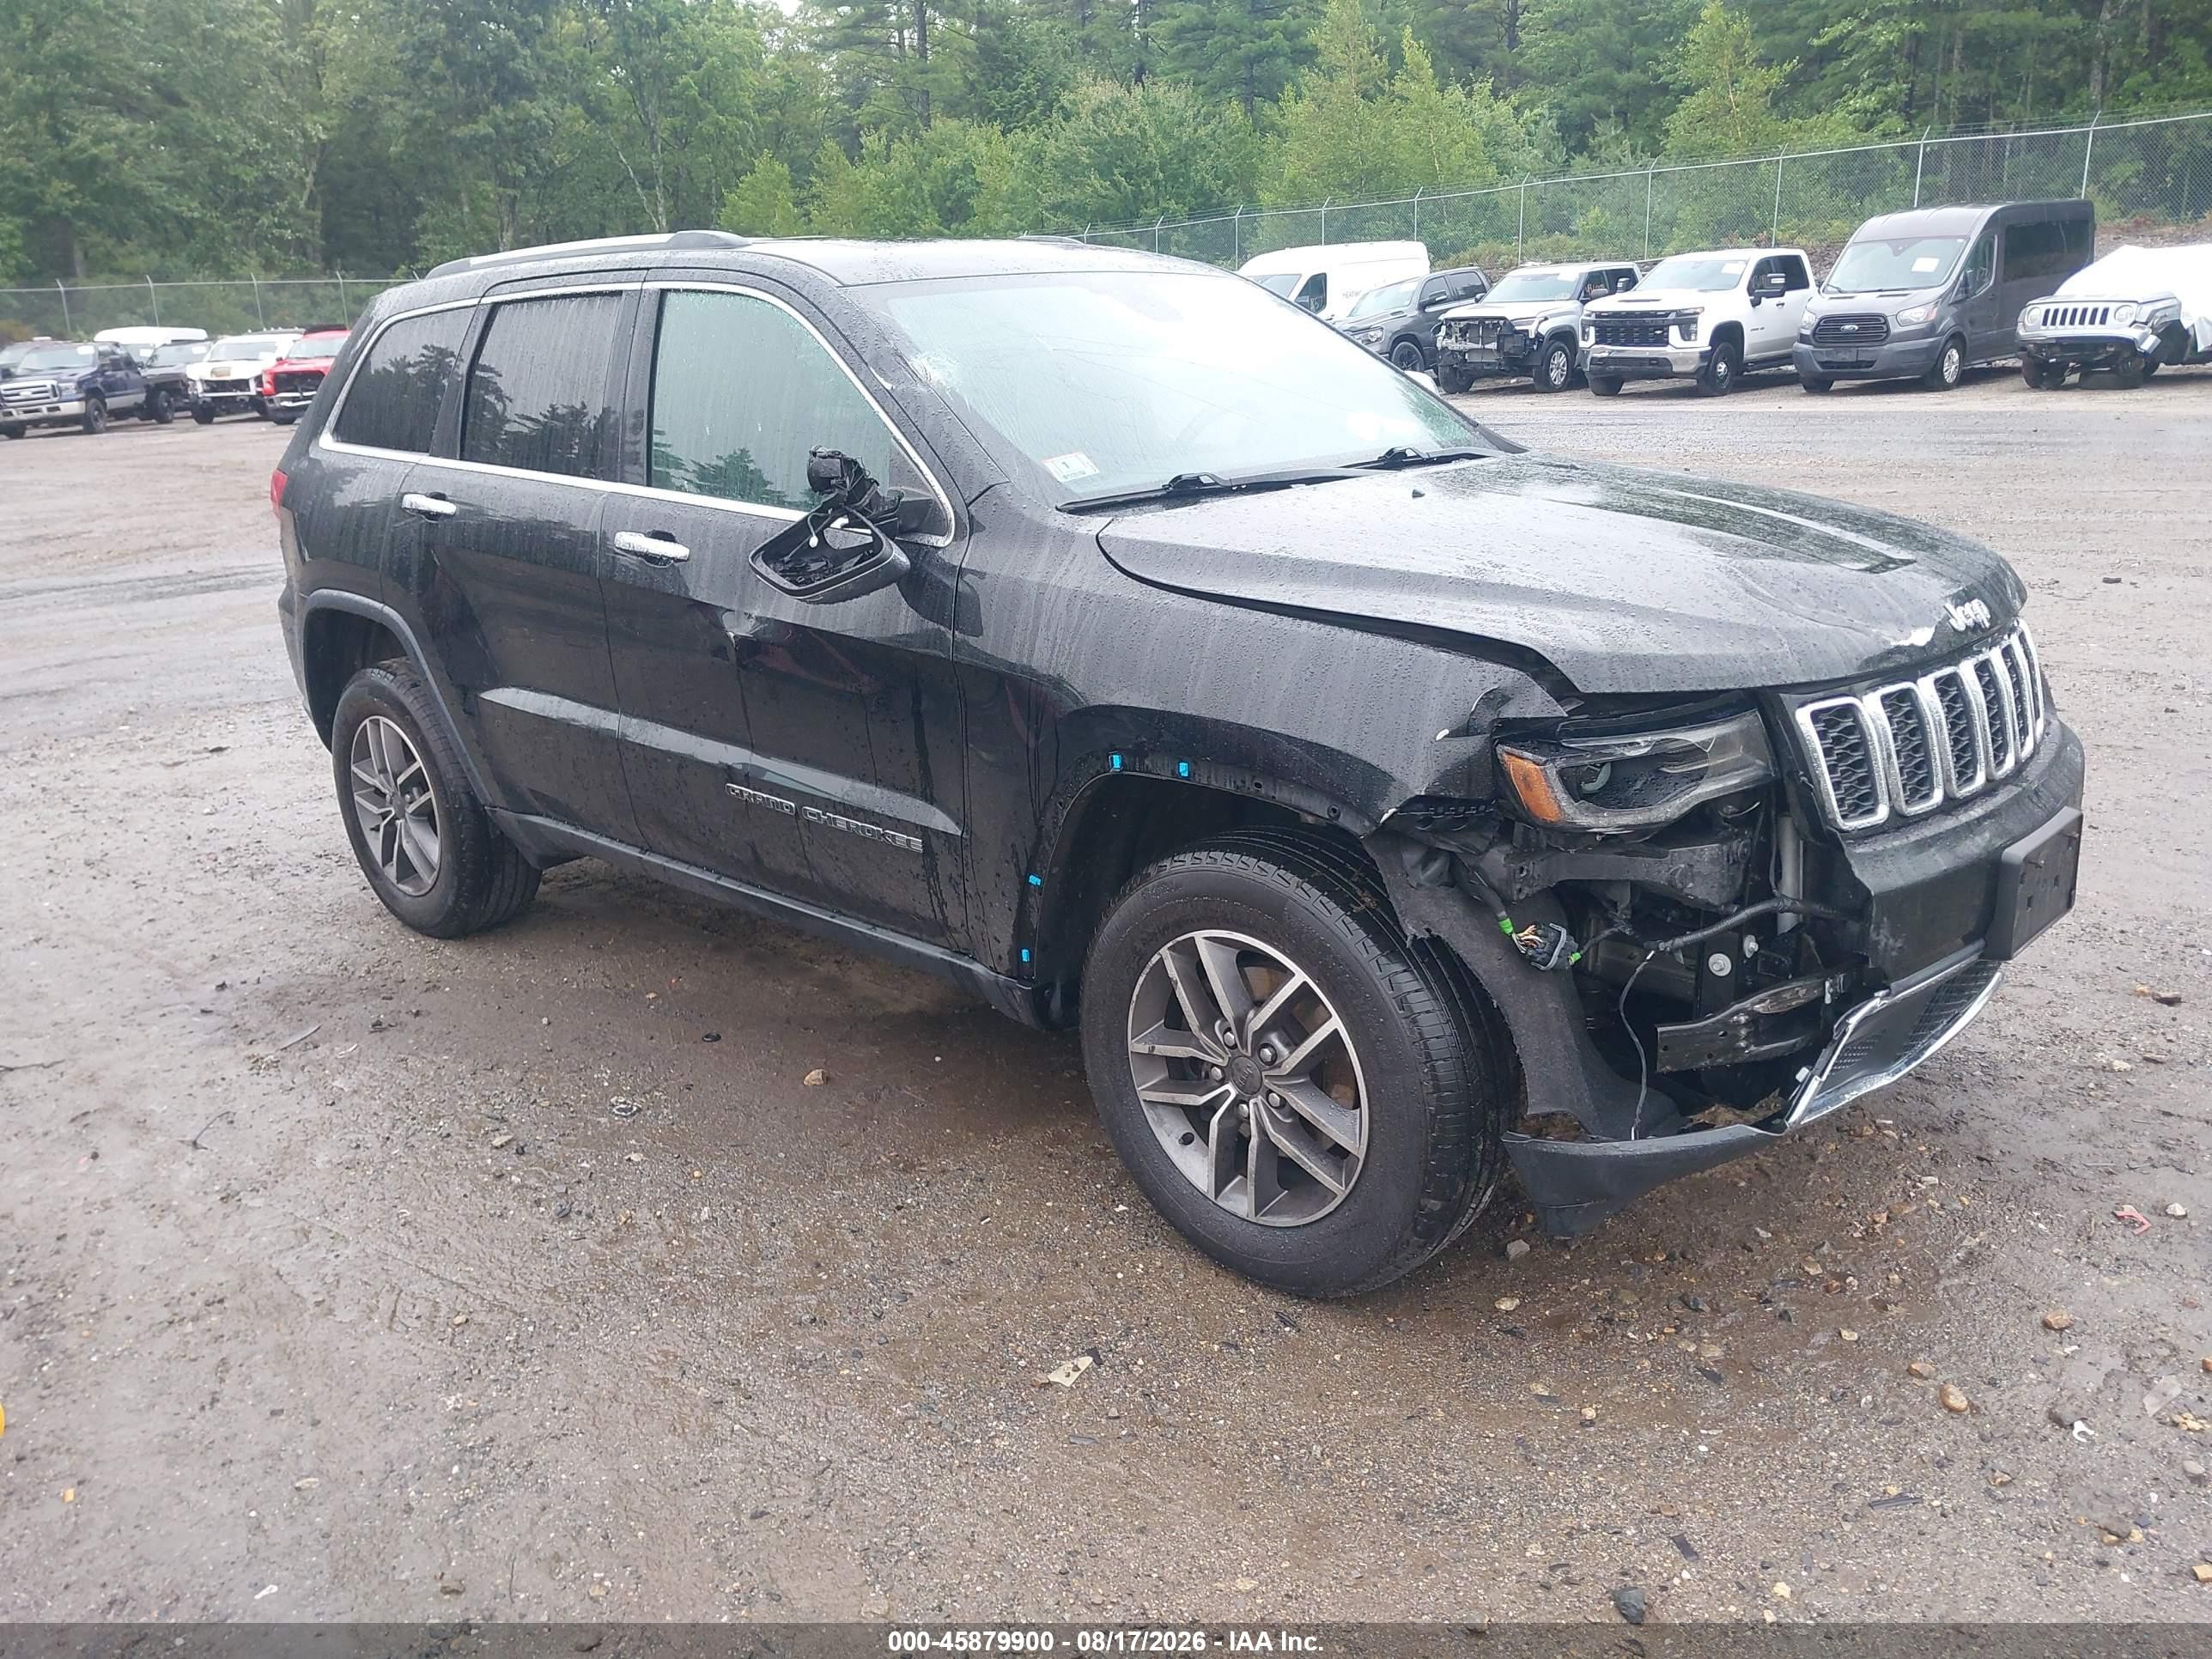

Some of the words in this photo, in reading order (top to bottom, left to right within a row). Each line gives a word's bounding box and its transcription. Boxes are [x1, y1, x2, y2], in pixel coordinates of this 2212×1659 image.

[1943, 599, 1991, 631] Jeep
[725, 783, 795, 815] GRAND
[802, 806, 923, 853] CHEROKEE
